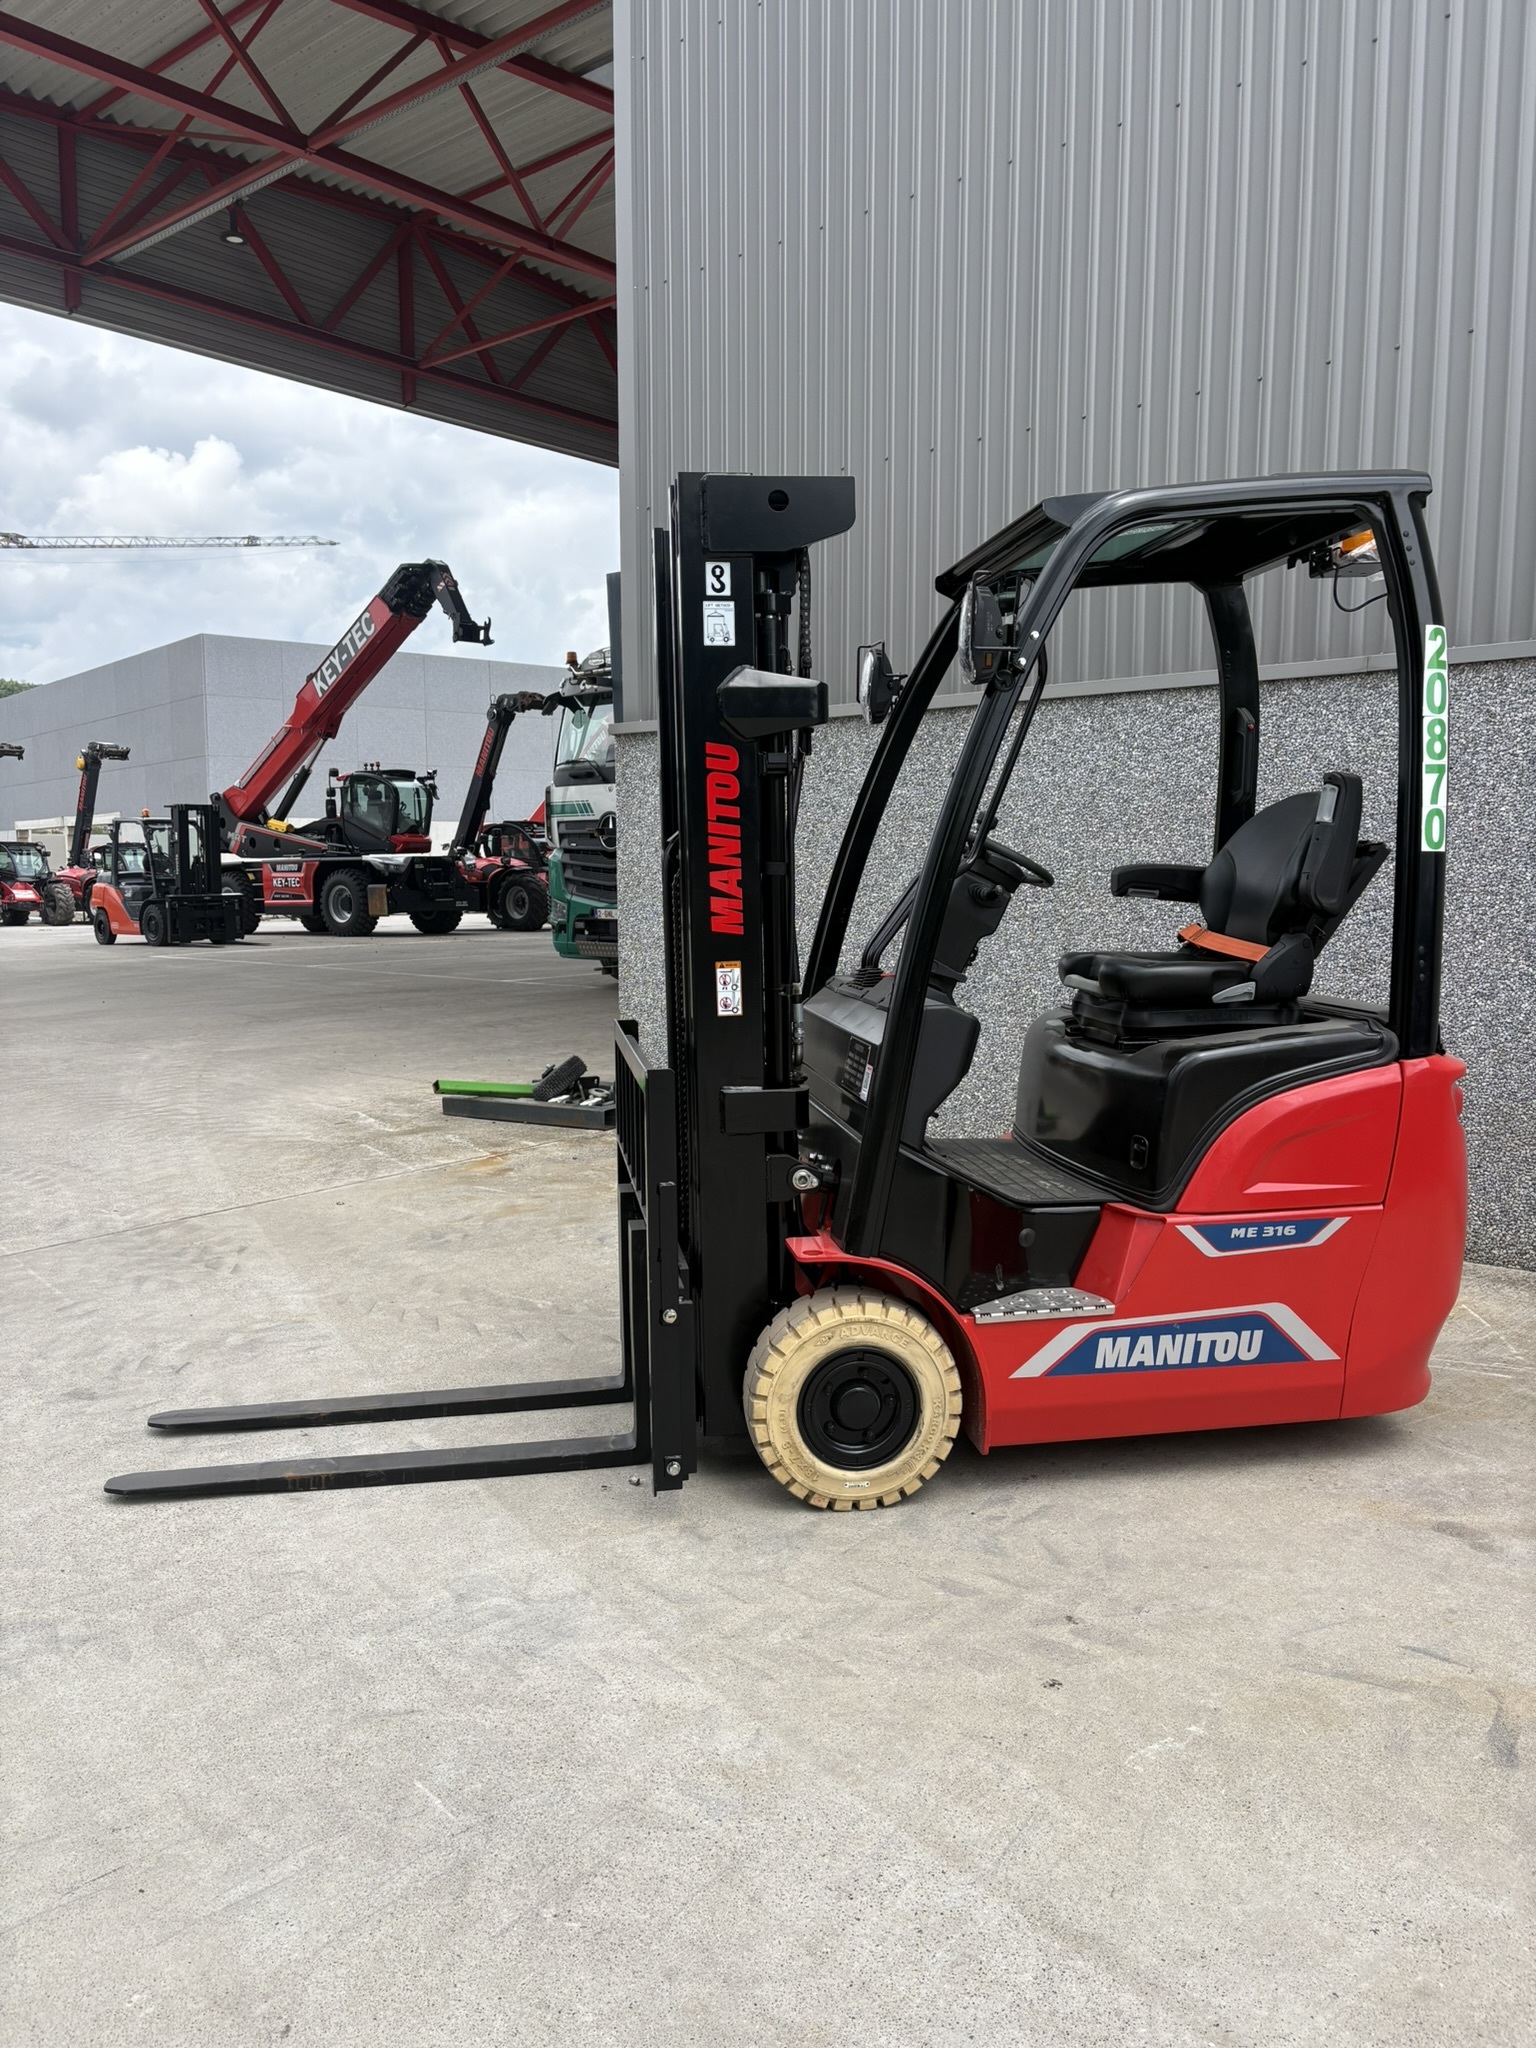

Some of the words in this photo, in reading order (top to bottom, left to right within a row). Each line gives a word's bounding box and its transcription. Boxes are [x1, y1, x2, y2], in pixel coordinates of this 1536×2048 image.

[312, 611, 375, 698] KEY-TEC
[476, 727, 494, 776] MANITOU
[1424, 627, 1447, 850] 20870
[227, 831, 247, 843] MRT
[706, 742, 744, 935] MANITOU
[273, 878, 300, 887] KEY-TEC
[1231, 1227, 1258, 1239] ME
[1262, 1225, 1297, 1237] 316
[840, 1325, 909, 1350] ADVANCE
[1094, 1330, 1264, 1369] MANITOU
